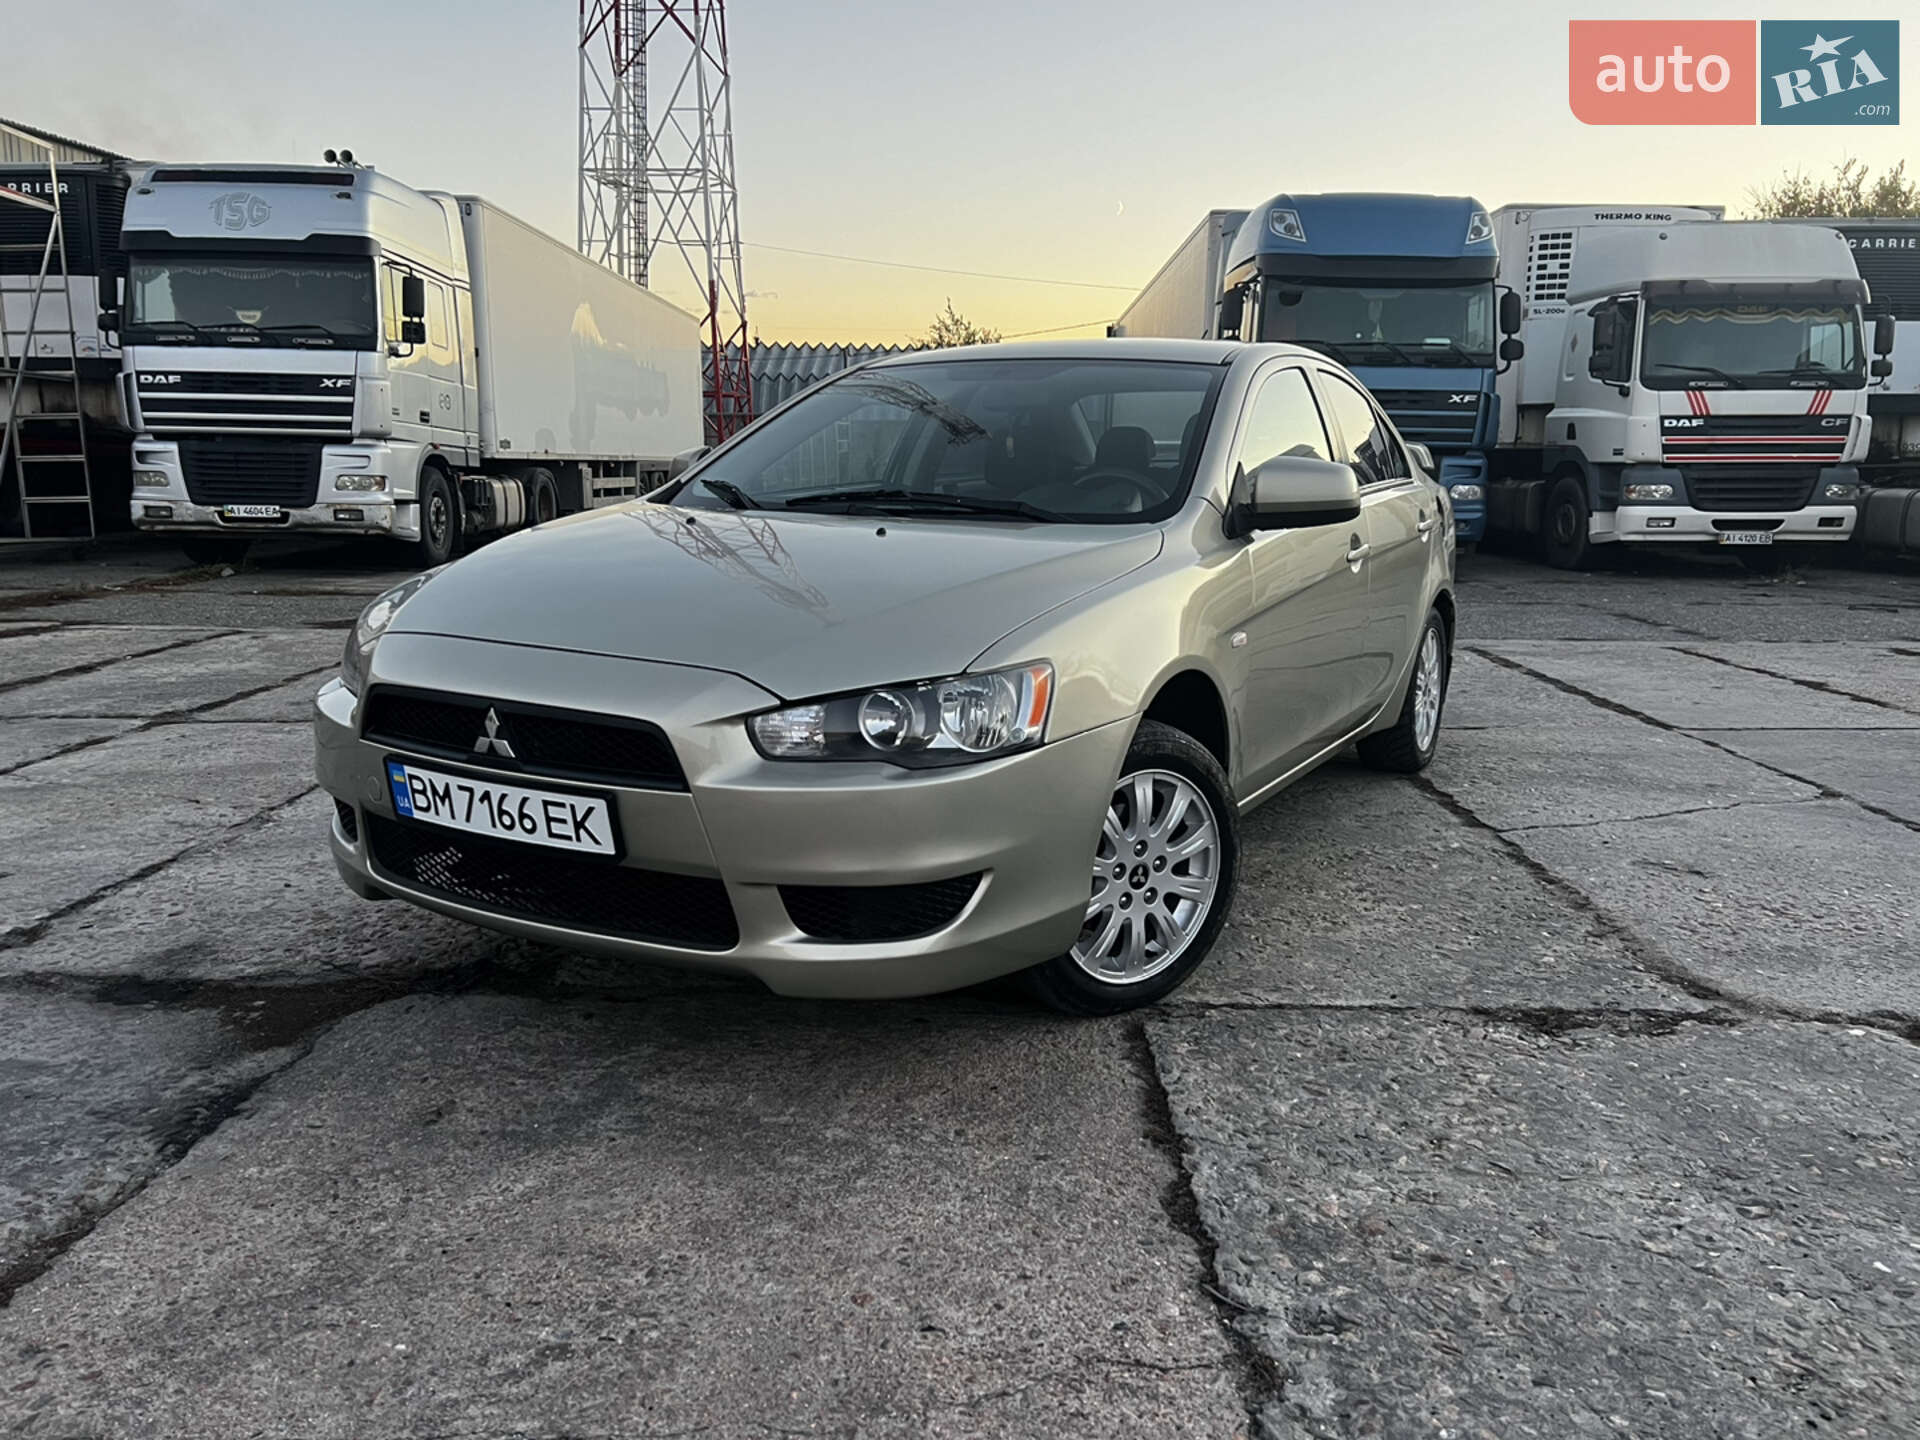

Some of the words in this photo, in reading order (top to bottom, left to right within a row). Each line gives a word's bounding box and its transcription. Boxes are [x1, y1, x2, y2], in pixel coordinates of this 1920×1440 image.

[1594, 212, 1642, 220] THERMO
[1644, 213, 1672, 221] KING
[139, 374, 182, 385] DAF
[319, 378, 353, 388] XF
[1447, 394, 1478, 403] XF
[1663, 418, 1705, 428] DAF
[1820, 418, 1849, 427] CF
[397, 795, 411, 809] UA
[407, 773, 456, 820] BM
[457, 784, 537, 835] 7166
[541, 799, 603, 846] EK
